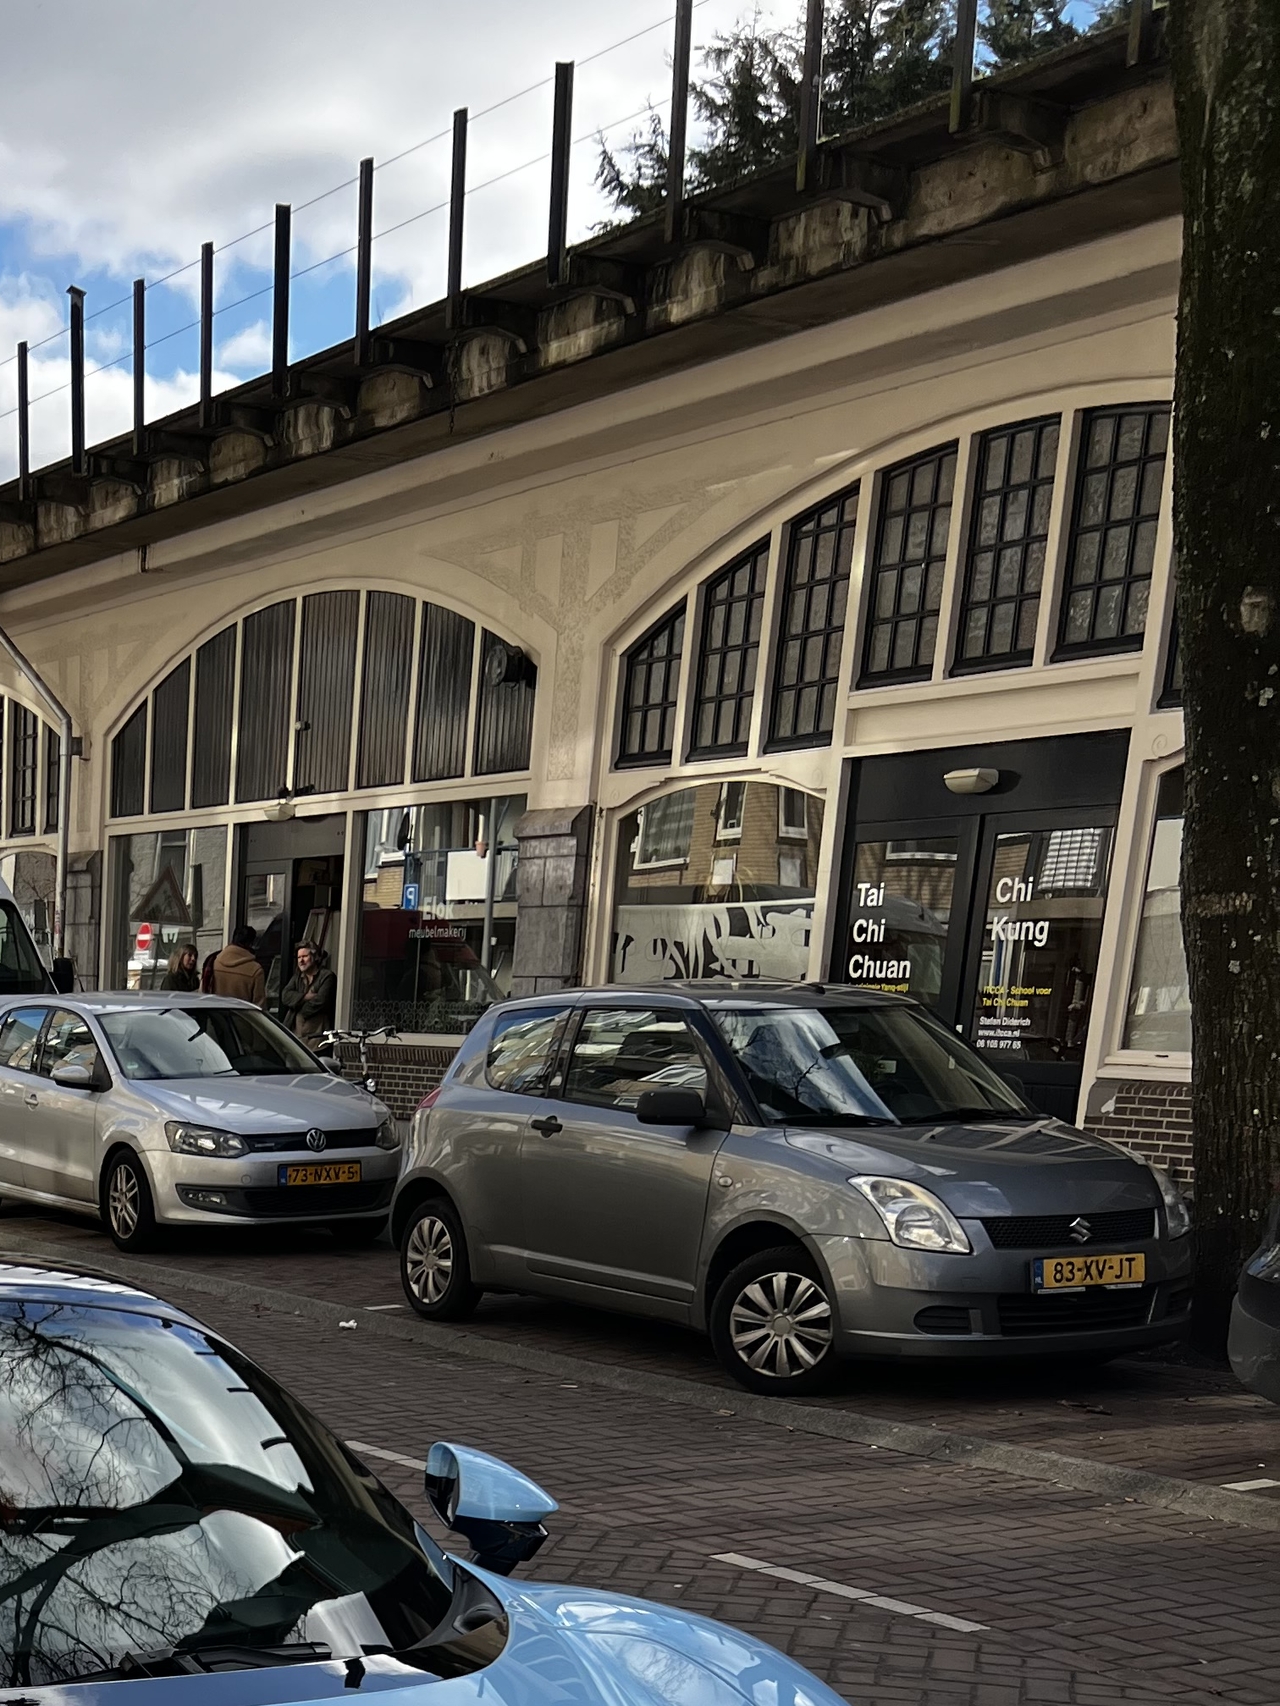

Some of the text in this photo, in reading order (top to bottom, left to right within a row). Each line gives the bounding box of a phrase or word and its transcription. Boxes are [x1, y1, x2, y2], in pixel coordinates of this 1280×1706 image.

[857, 882, 885, 907] Tai
[996, 876, 1034, 903] Chi
[422, 896, 455, 920] Elok
[408, 924, 467, 942] meubelmakerij
[852, 918, 886, 943] Chi
[991, 916, 1050, 947] Kung
[848, 954, 911, 979] Chuan
[983, 997, 992, 1006] Tai
[1006, 998, 1029, 1007] Chuan
[1010, 986, 1035, 995] School
[292, 1165, 355, 1184] 73-NXV-5
[1053, 1257, 1136, 1284] 83-XV-JT
